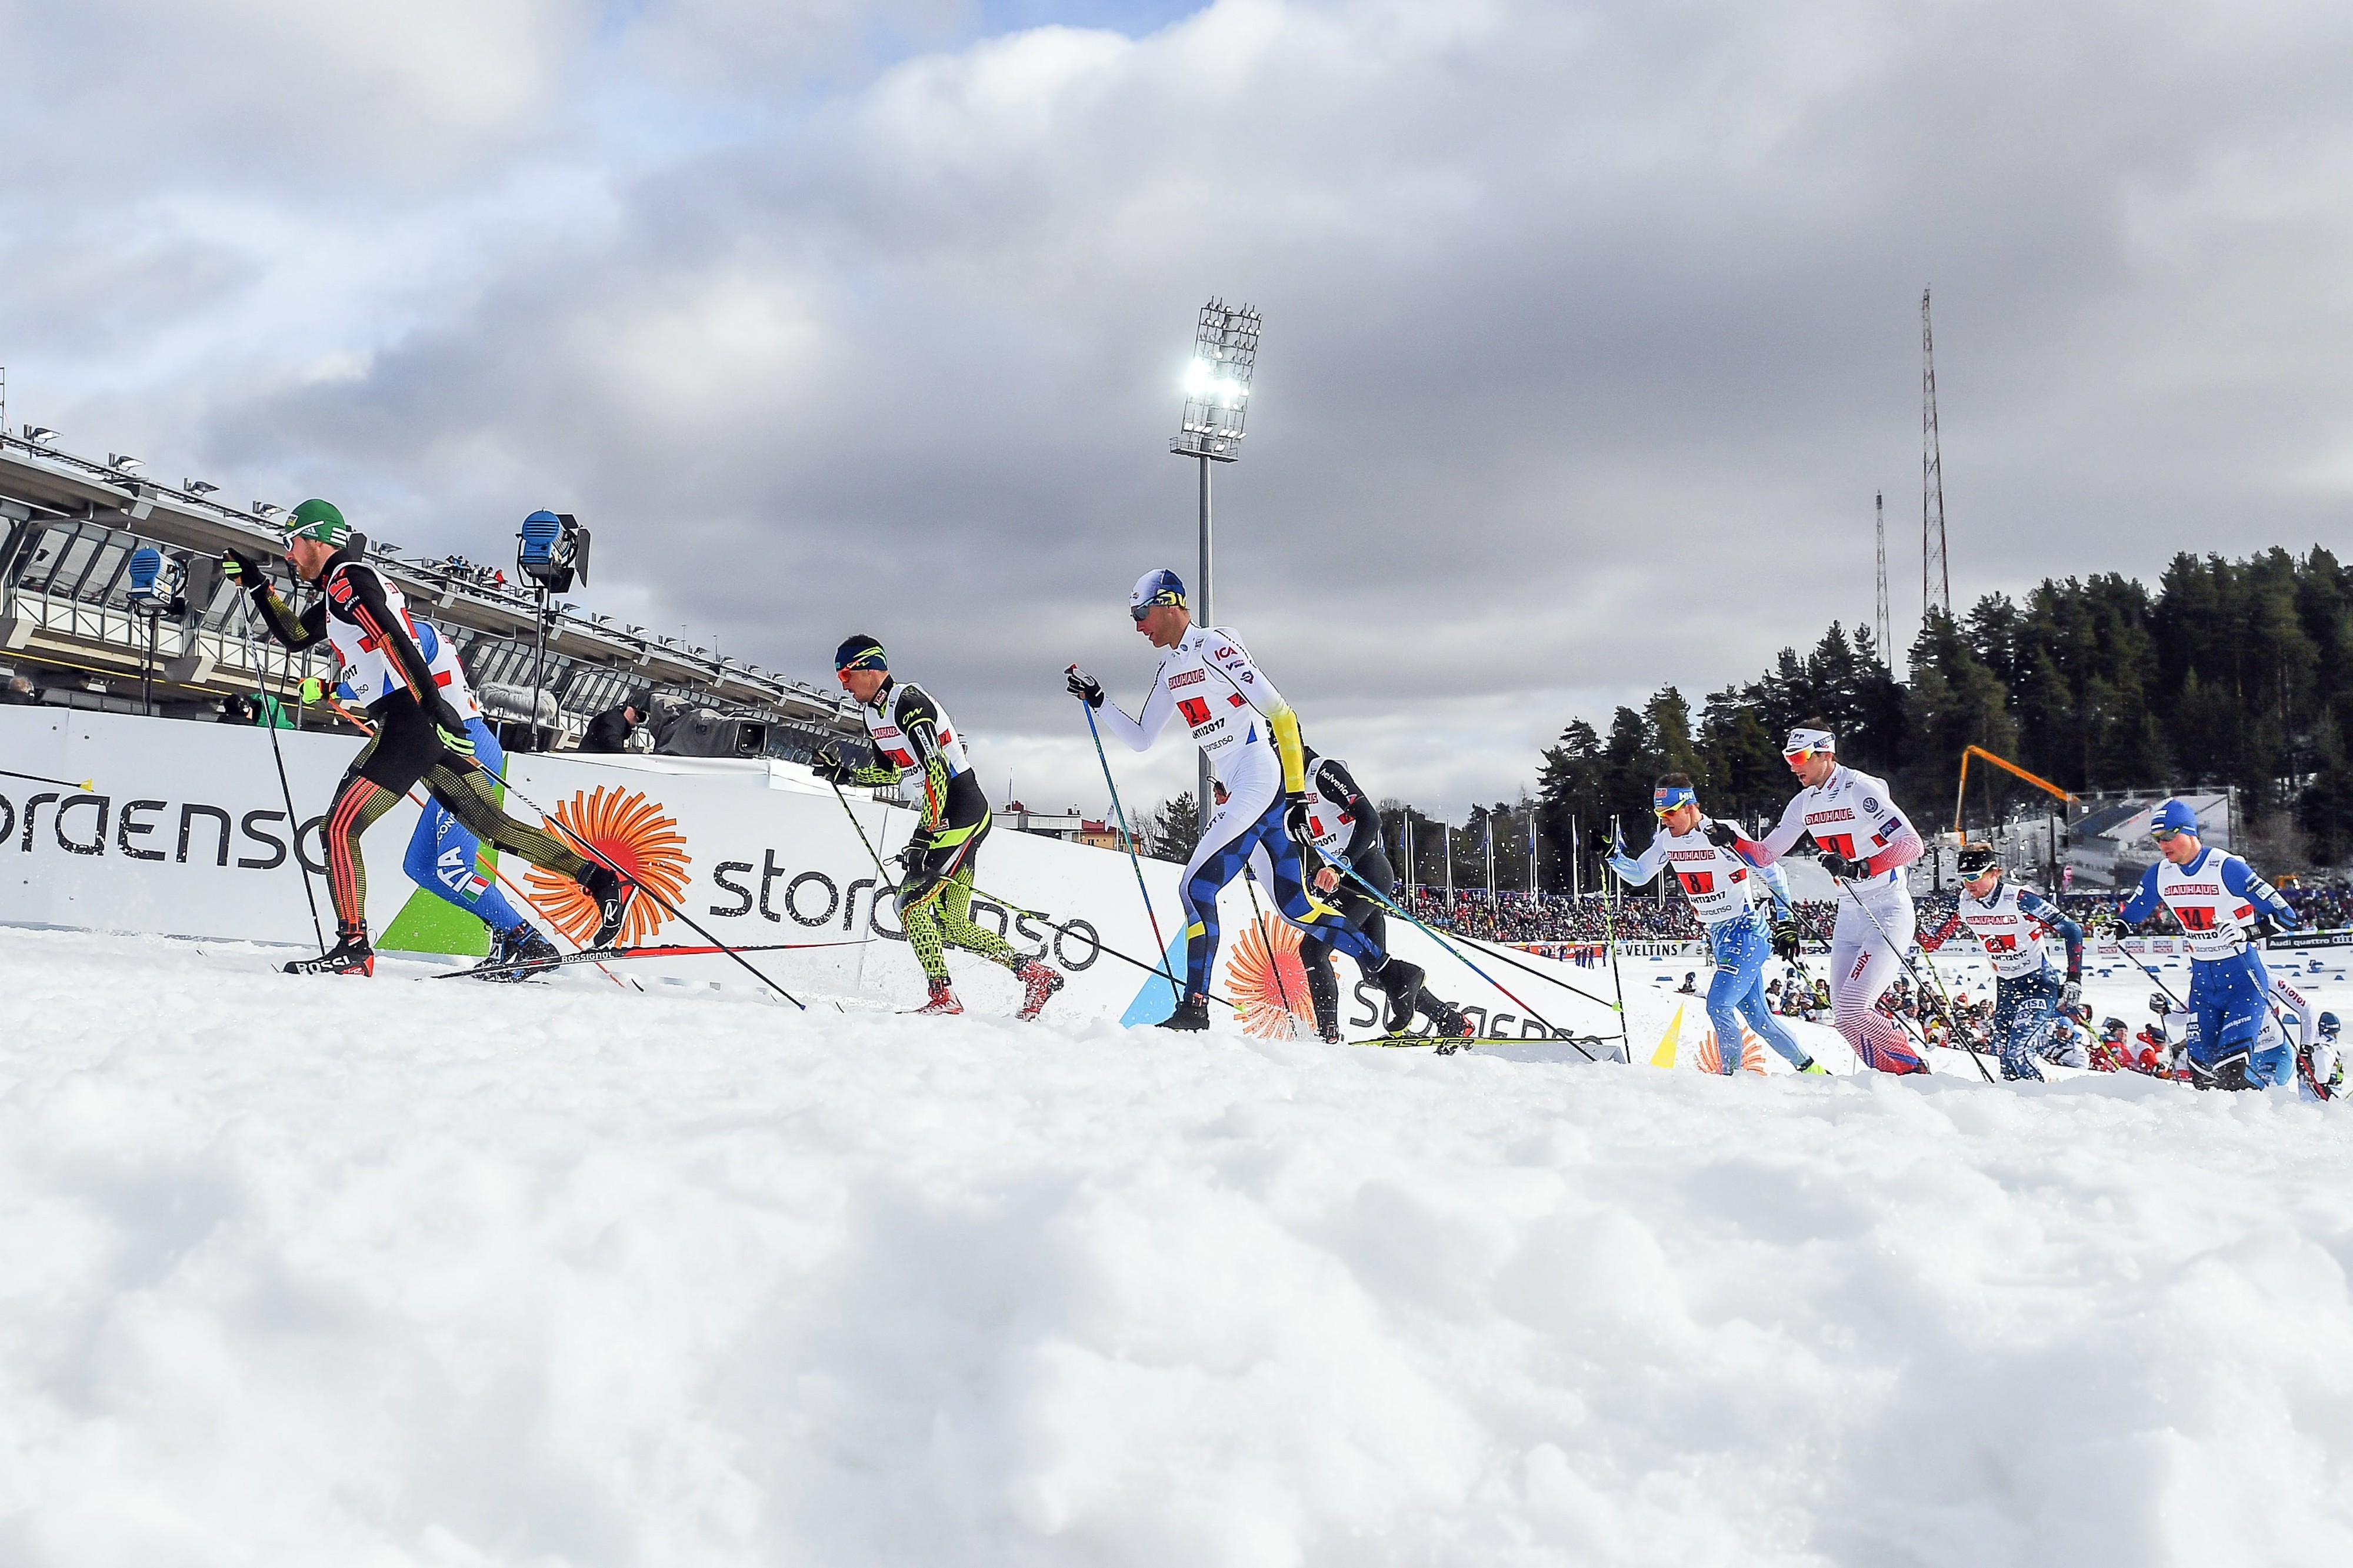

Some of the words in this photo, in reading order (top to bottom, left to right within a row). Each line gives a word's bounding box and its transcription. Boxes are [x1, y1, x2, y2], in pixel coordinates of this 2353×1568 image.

[1214, 646, 1238, 661] ICA
[1319, 768, 1348, 796] helvetia
[1805, 808, 1855, 825] BAUHAUS
[436, 845, 474, 893] ITA
[1688, 873, 1701, 893] 8
[2165, 885, 2219, 896] BAUHAUS
[2182, 909, 2204, 929] 14
[1625, 943, 1678, 956] VELTINS
[2294, 939, 2330, 947] quattro
[561, 950, 615, 963] ROSSIGNOL
[1851, 950, 1872, 982] swix
[2020, 1000, 2045, 1008] VISA
[2284, 987, 2306, 1007] LOTOS
[1382, 1038, 1474, 1049] FISCHER
